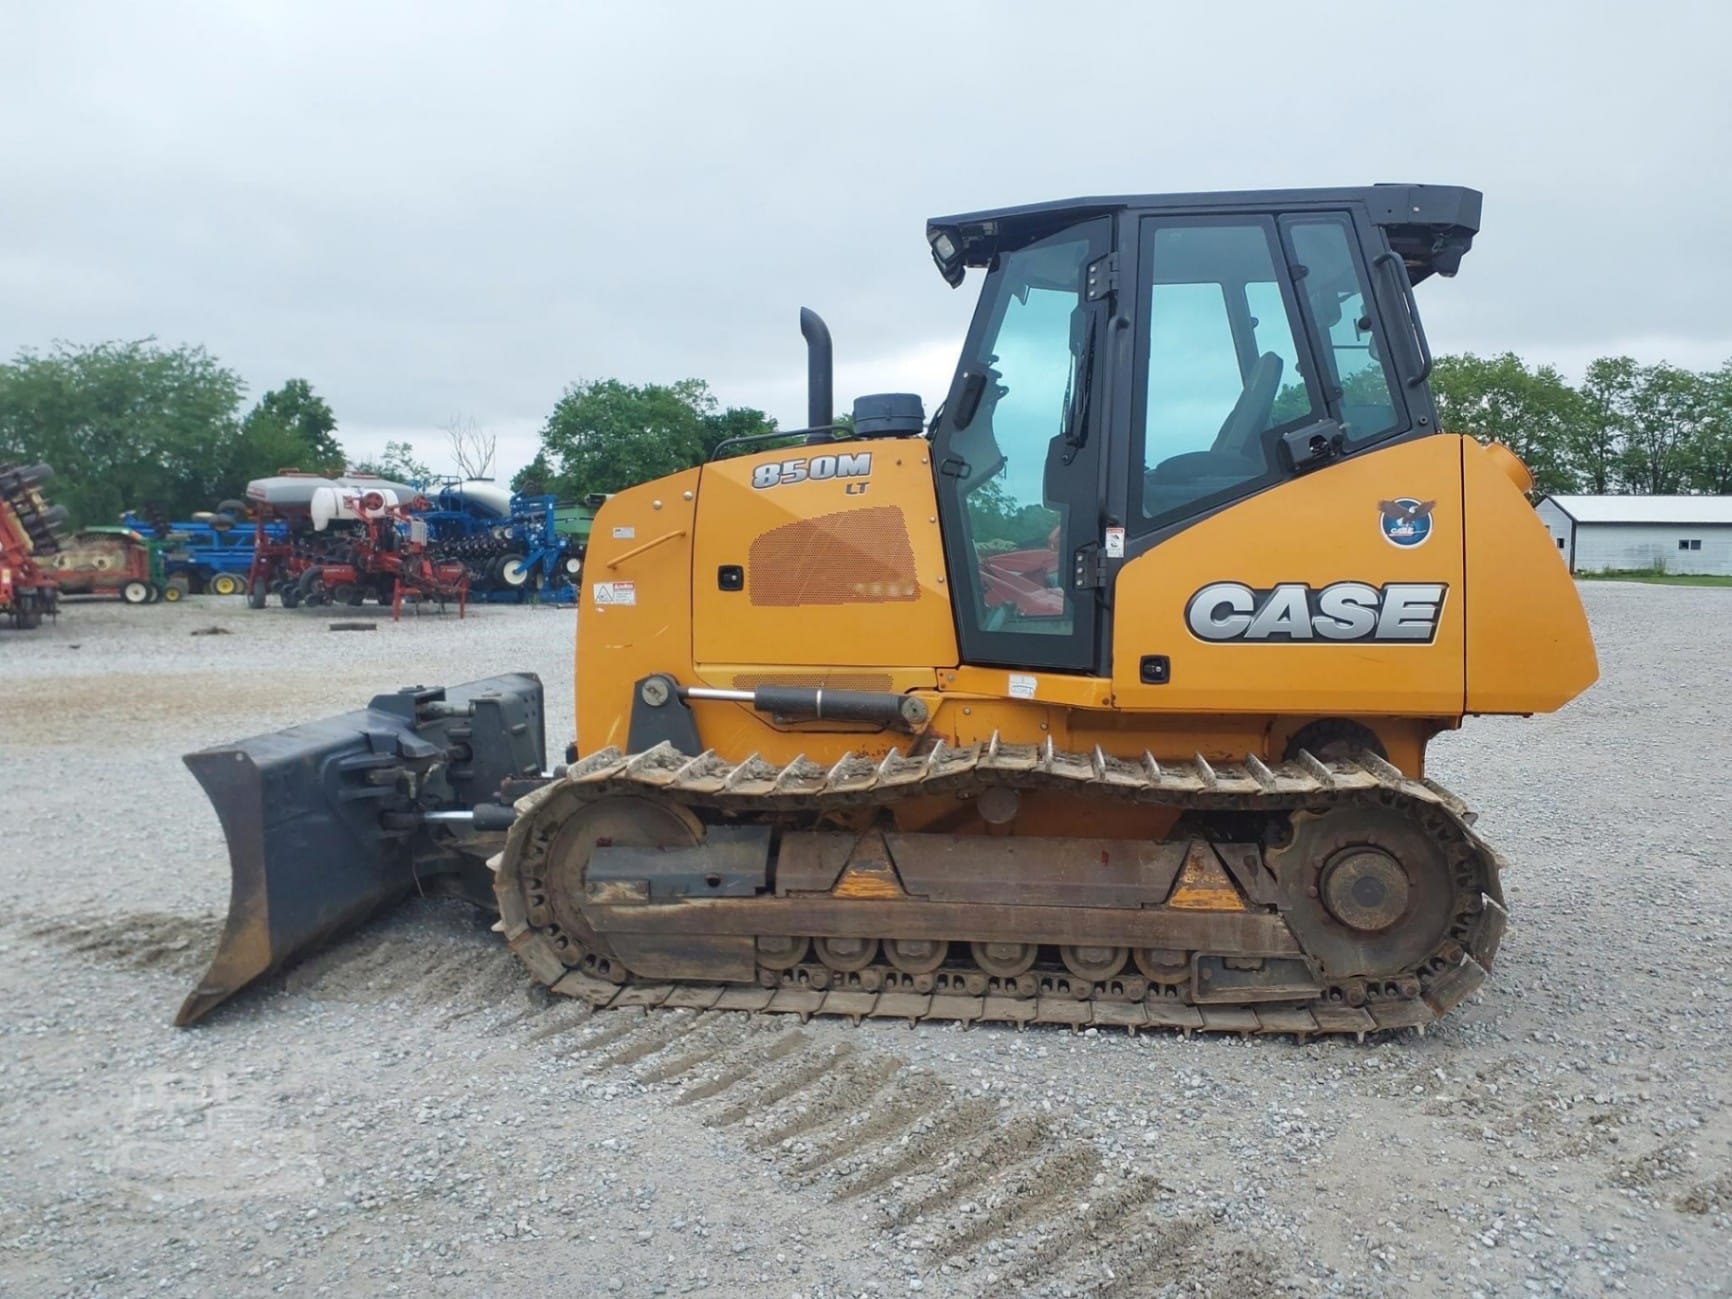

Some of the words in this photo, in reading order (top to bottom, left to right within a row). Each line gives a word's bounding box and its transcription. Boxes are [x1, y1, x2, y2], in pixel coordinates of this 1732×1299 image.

[752, 452, 872, 488] 850M
[845, 482, 870, 495] LT
[1185, 581, 1447, 642] CASE
